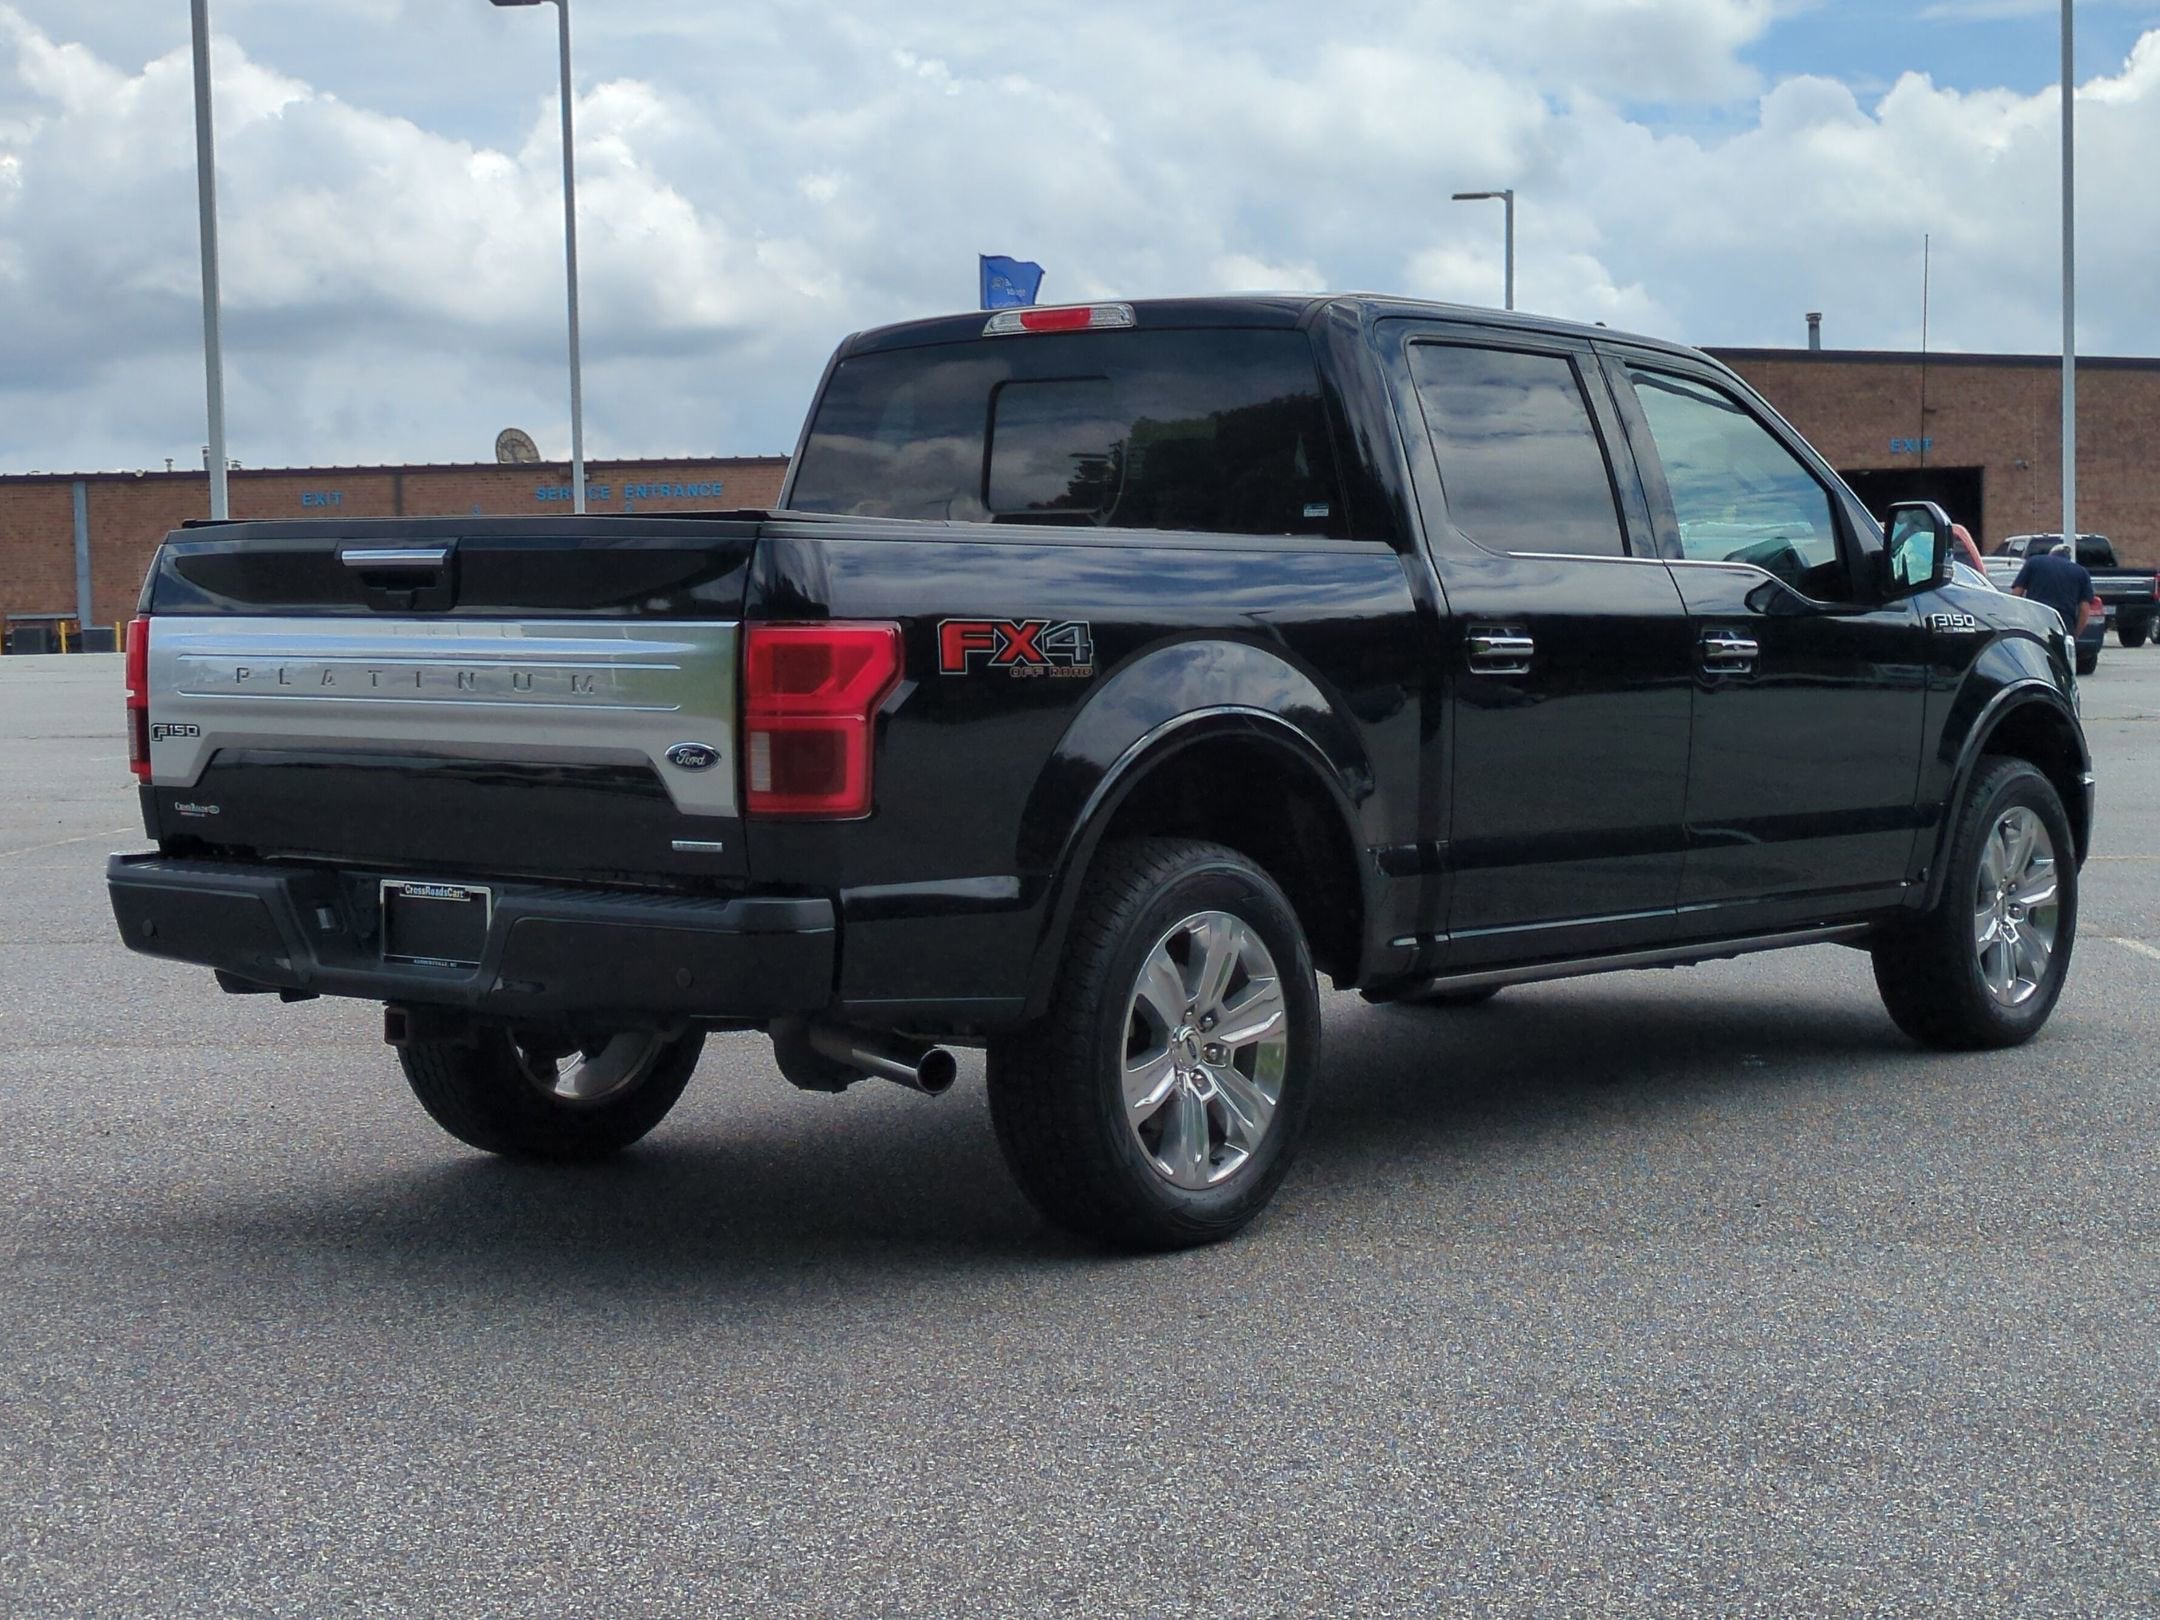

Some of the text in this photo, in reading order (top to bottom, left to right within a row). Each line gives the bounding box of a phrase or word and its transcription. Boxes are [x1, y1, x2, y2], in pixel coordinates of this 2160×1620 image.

[1889, 437, 1933, 454] EXIT
[302, 490, 343, 507] EXIT
[535, 481, 724, 501] SERCE ENTRANCE
[1931, 613, 1976, 631] F150
[937, 618, 1094, 675] FX4
[235, 666, 596, 696] PLATINUM
[151, 723, 200, 742] F150
[675, 748, 707, 766] Ford
